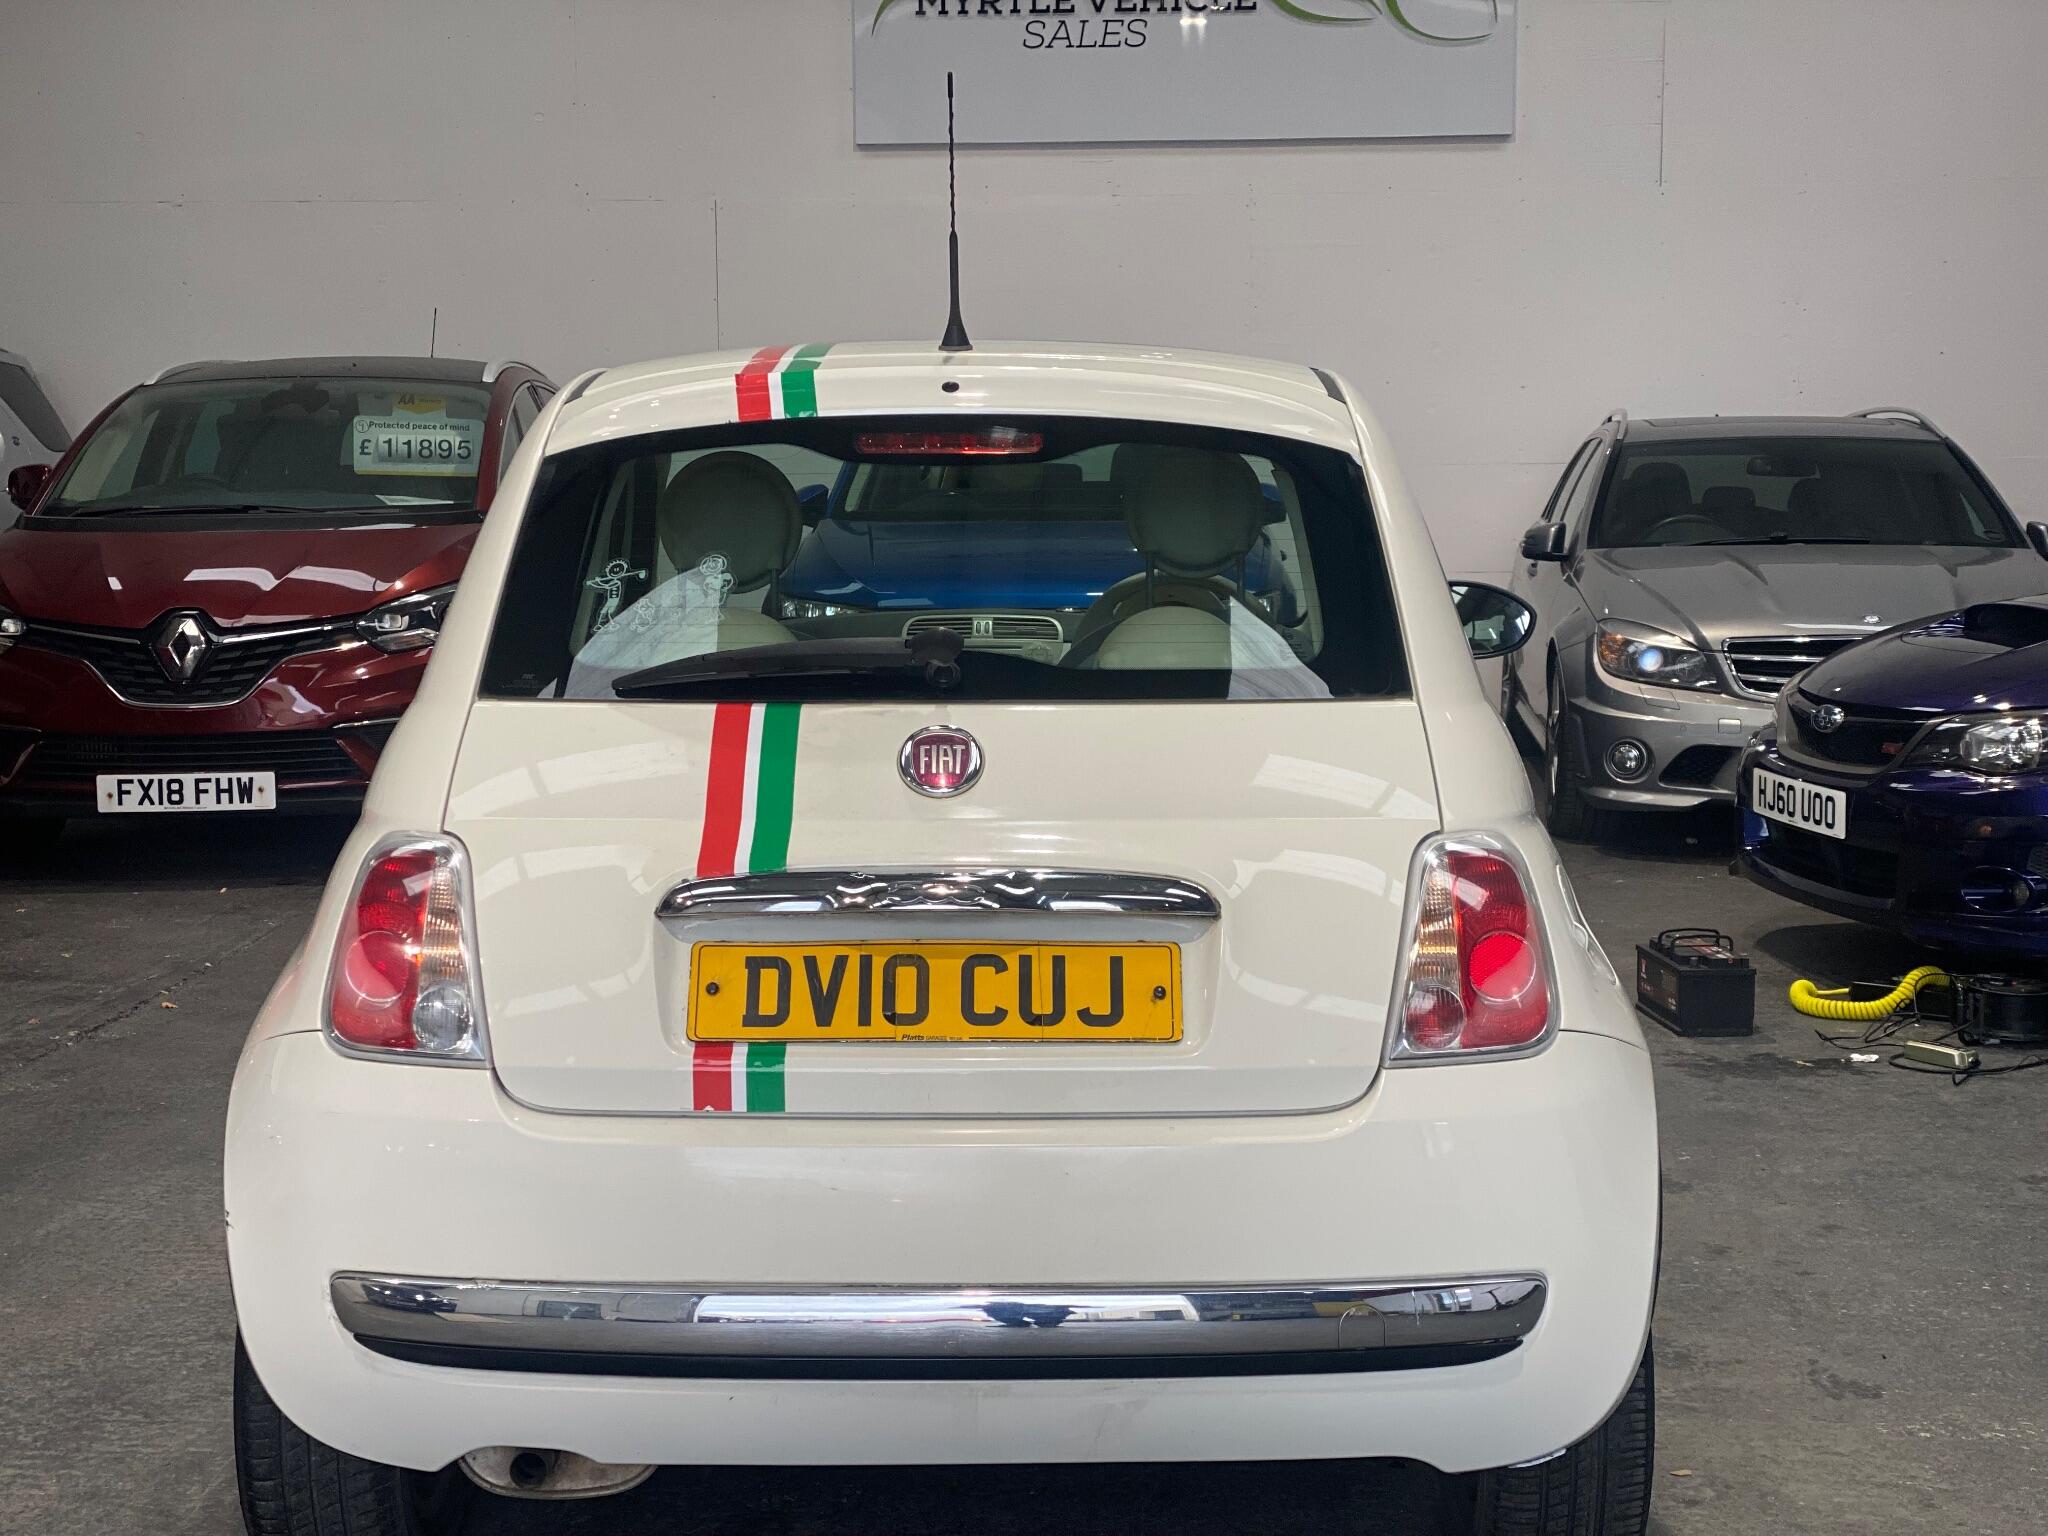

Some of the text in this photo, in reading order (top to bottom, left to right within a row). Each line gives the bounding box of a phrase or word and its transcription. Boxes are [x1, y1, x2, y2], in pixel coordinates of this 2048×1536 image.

[1023, 19, 1148, 49] SALES
[369, 421, 470, 432] Protected peace of mind
[382, 438, 472, 460] 11895
[919, 744, 966, 775] FIAT
[116, 776, 254, 806] FX18 FHW
[1758, 774, 1836, 830] HJ60 UOO
[741, 953, 1124, 1028] DV10 CUJ
